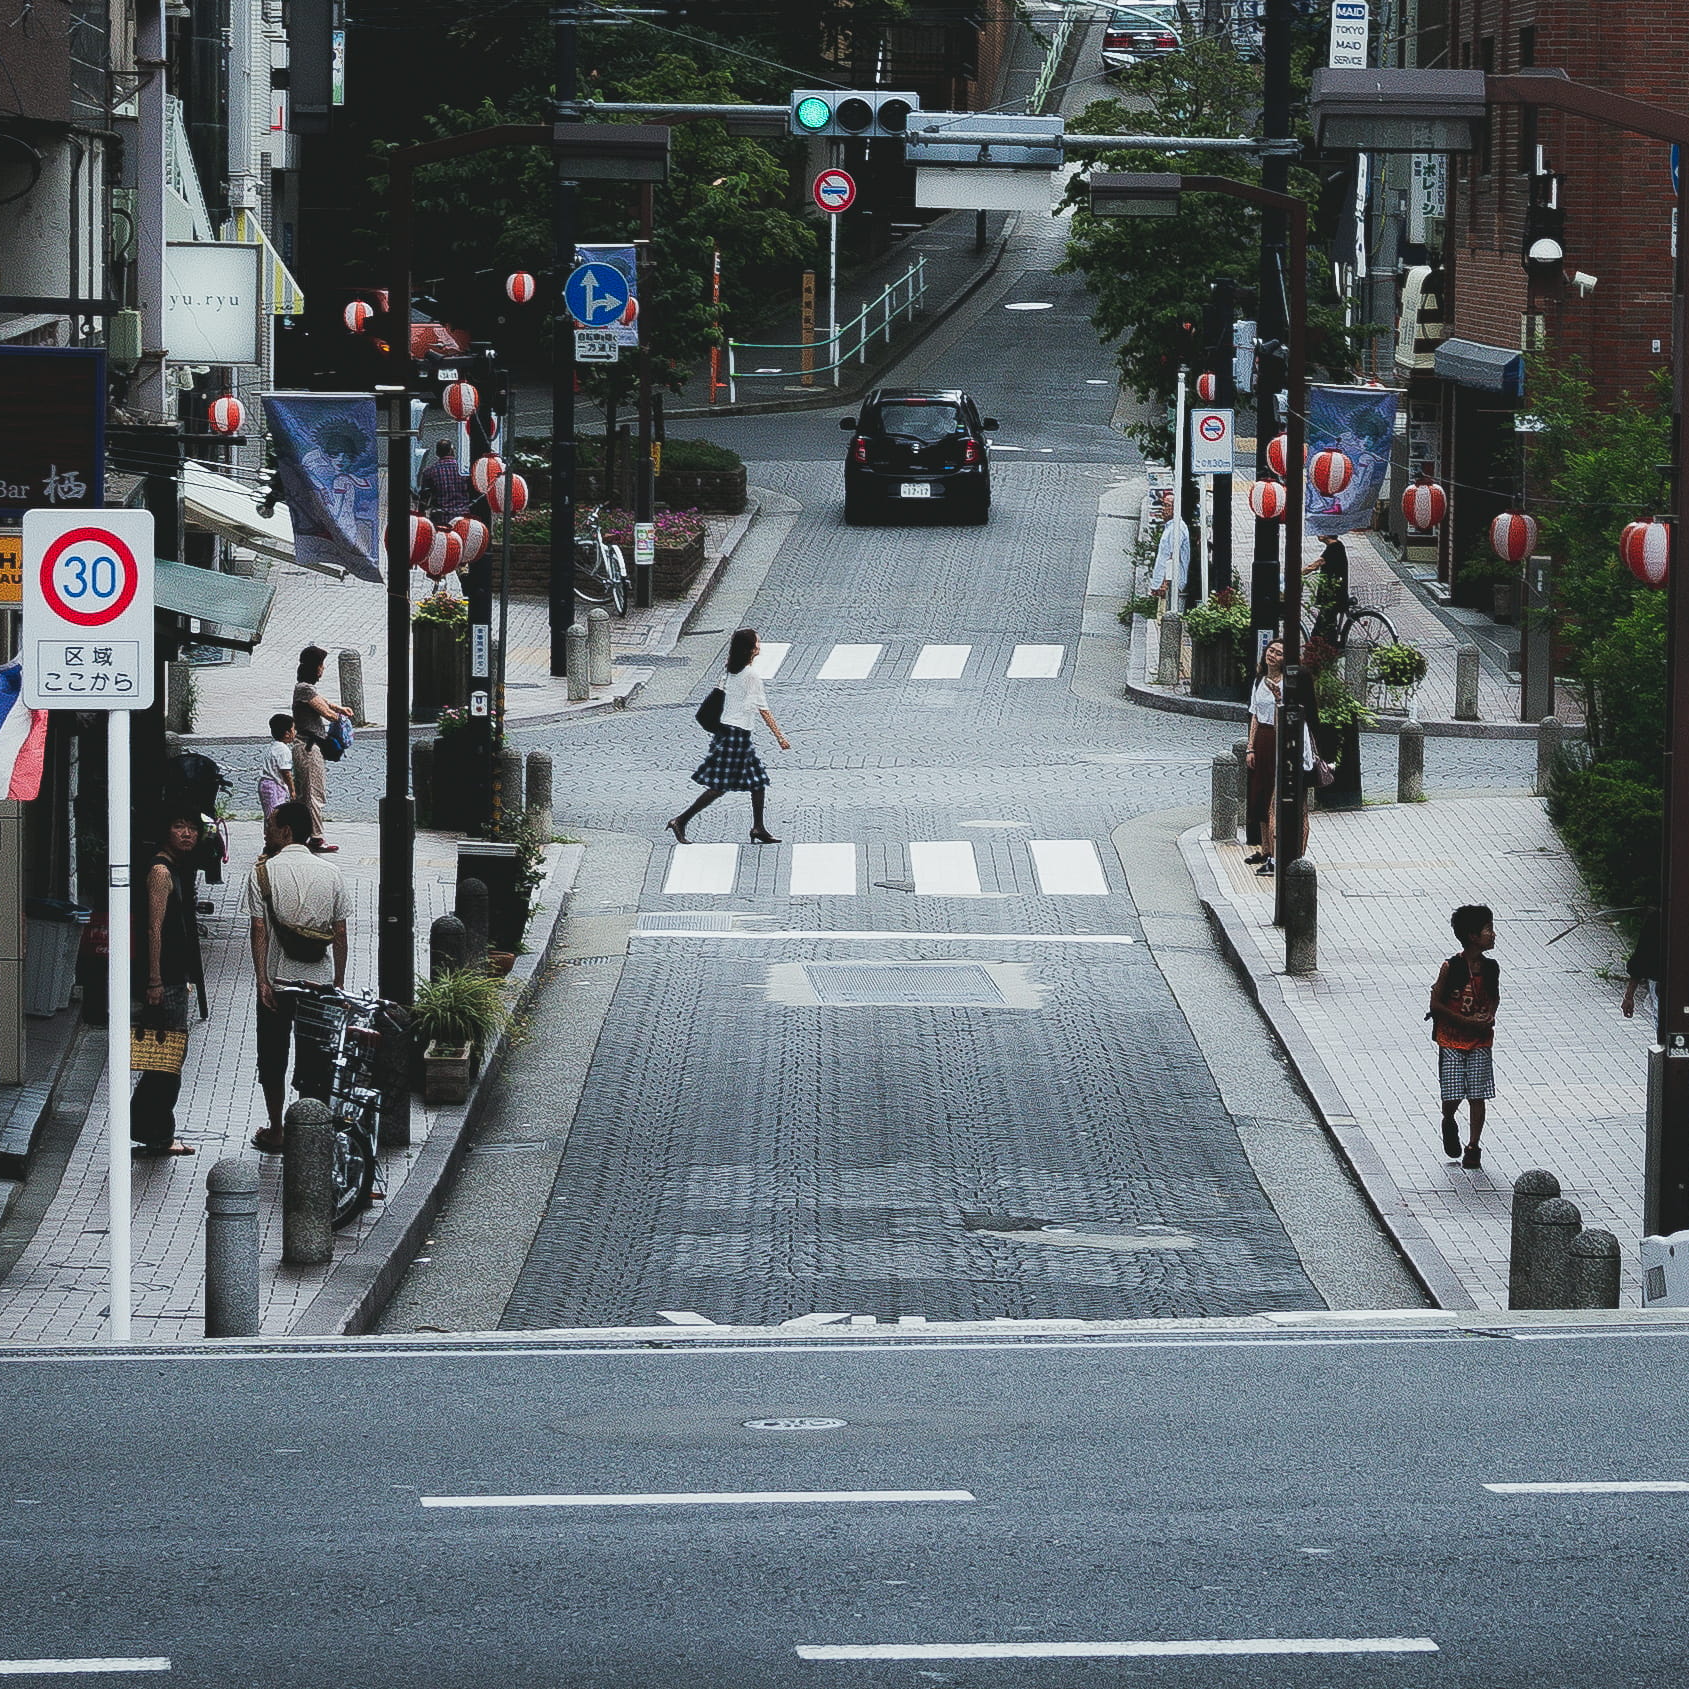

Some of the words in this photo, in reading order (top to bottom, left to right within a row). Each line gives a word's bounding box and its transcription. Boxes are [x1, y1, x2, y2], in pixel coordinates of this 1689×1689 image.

[1336, 6, 1365, 18] MAID
[1336, 25, 1365, 35] TOKYO
[1336, 40, 1362, 50] MAID
[1334, 55, 1363, 65] SERVICE
[168, 294, 240, 312] yu.ryu
[62, 555, 117, 598] 30
[64, 646, 113, 667] 区域
[44, 672, 134, 692] ここから
